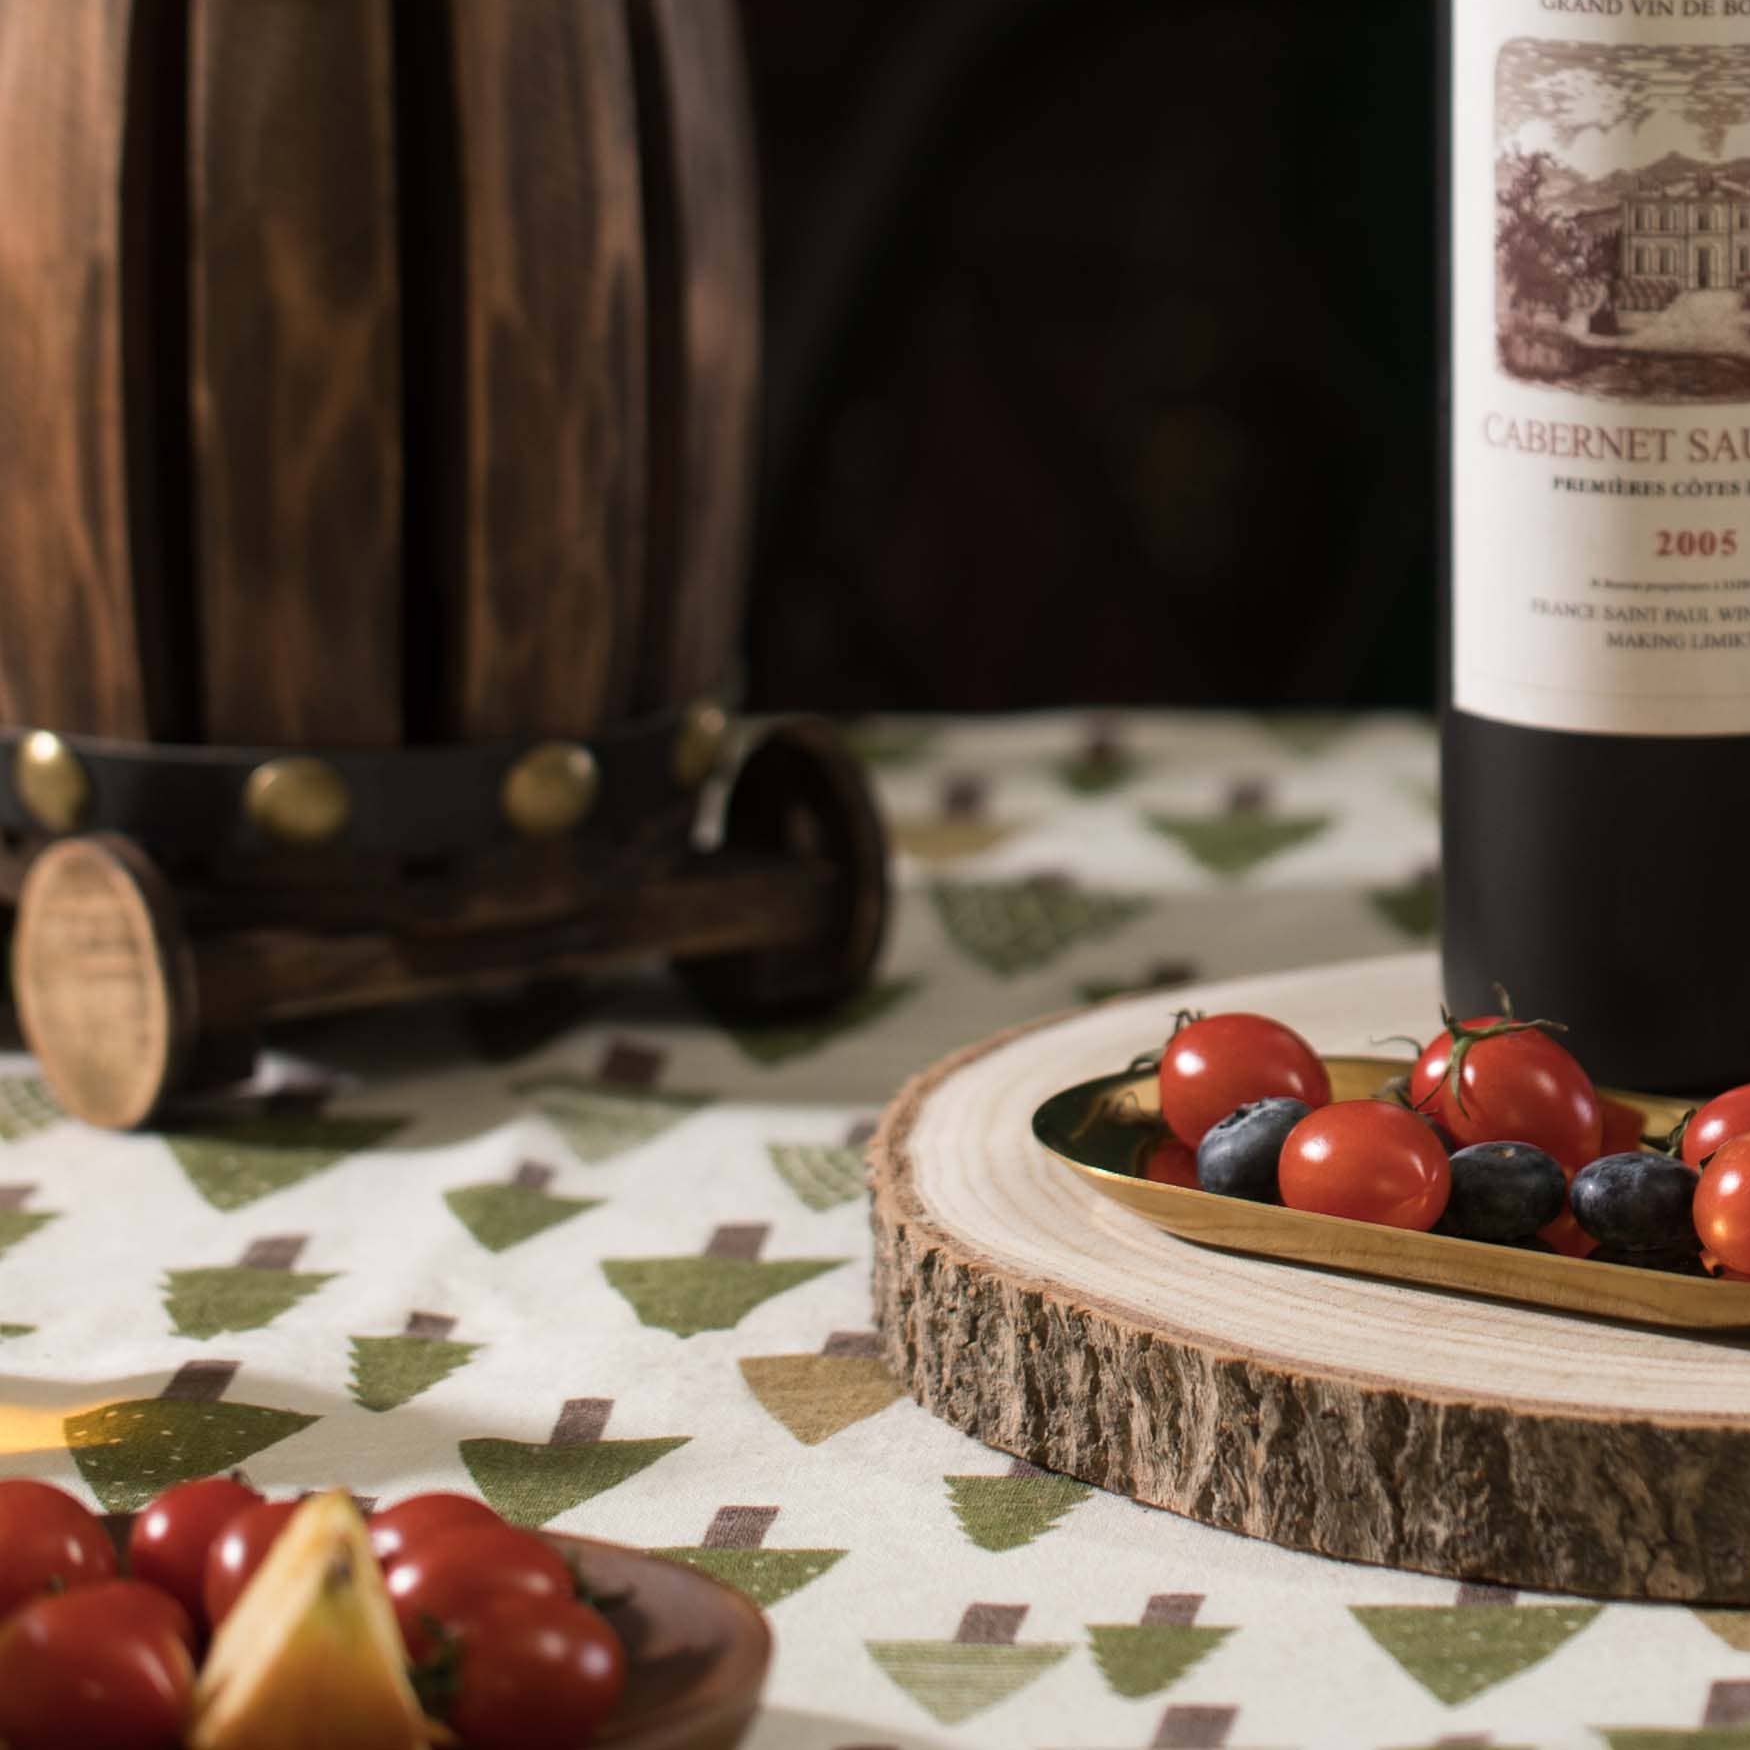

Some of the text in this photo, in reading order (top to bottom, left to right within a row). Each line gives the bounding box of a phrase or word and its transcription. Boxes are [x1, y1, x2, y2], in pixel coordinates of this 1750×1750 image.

[1631, 0, 1674, 17] VIN
[1484, 412, 1677, 463] CABERNET
[1655, 531, 1738, 557] 2005
[1530, 598, 1596, 619] FRANCE
[1603, 605, 1658, 622] SAINT
[1663, 606, 1712, 623] PAUL
[1606, 631, 1685, 649] MAKING
